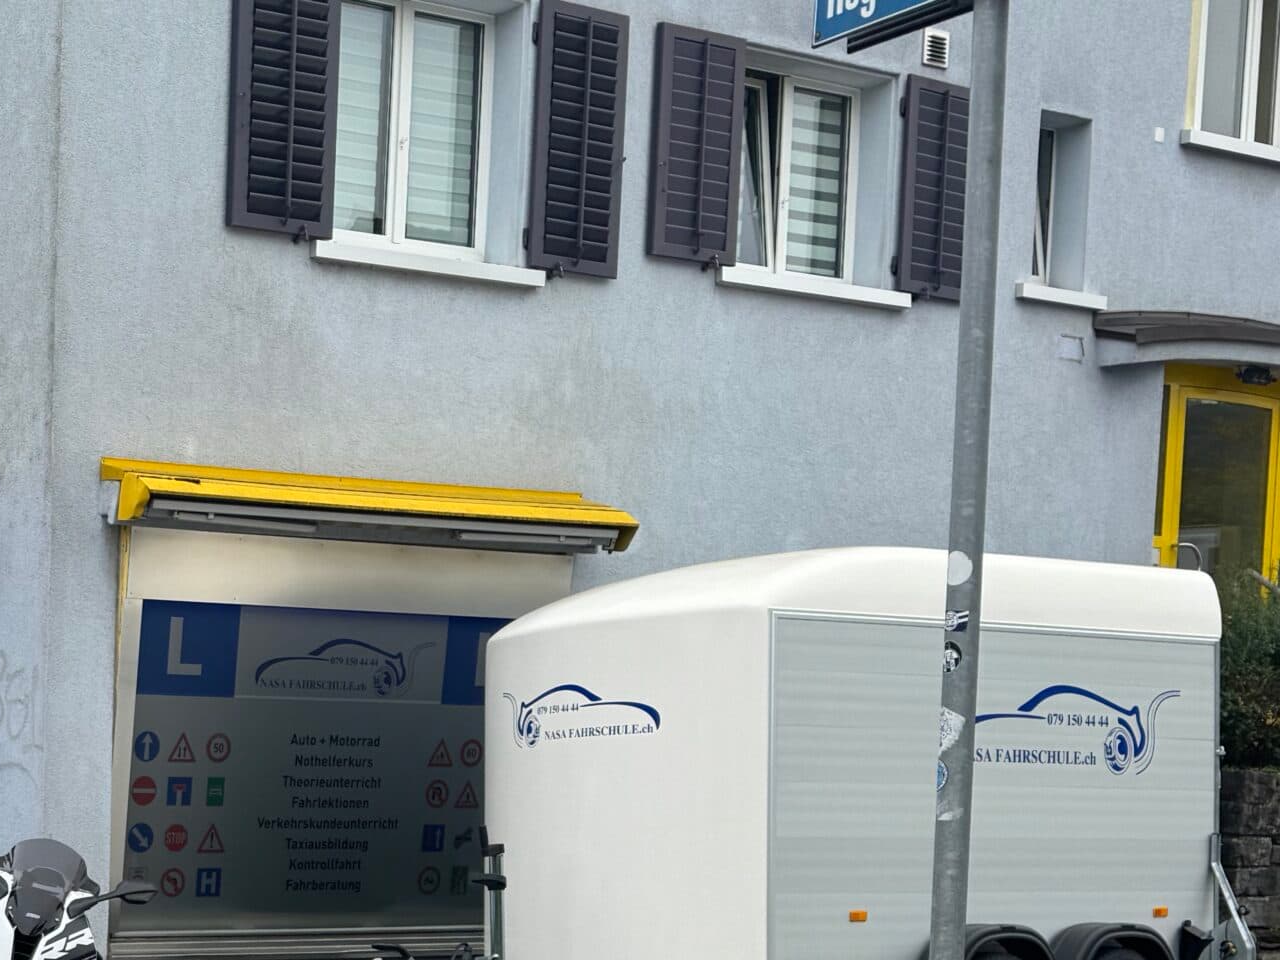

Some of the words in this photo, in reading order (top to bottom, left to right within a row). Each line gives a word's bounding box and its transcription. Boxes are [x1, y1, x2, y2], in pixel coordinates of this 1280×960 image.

[167, 616, 202, 676] L
[259, 679, 286, 689] NASA
[560, 703, 569, 712] 44
[570, 702, 579, 712] 44
[1047, 713, 1064, 726] 079
[1067, 713, 1082, 727] 150
[1084, 714, 1096, 727] 44
[1098, 715, 1109, 728] 44
[544, 729, 567, 740] NASA
[568, 724, 653, 738] FAHRSCHULE.ch
[290, 733, 316, 746] Auto
[329, 735, 380, 747] Motorrad
[294, 755, 374, 768] Nothelferkurs
[995, 749, 1097, 766] FAHRSCHULE.ch
[282, 775, 381, 789] Theorieunterricht
[257, 816, 399, 830] Verkehrskundeunterricht
[285, 838, 368, 852] Taxiausbildung
[289, 858, 361, 871] Kontrollfahrt
[285, 879, 361, 893] Fahrberatung
